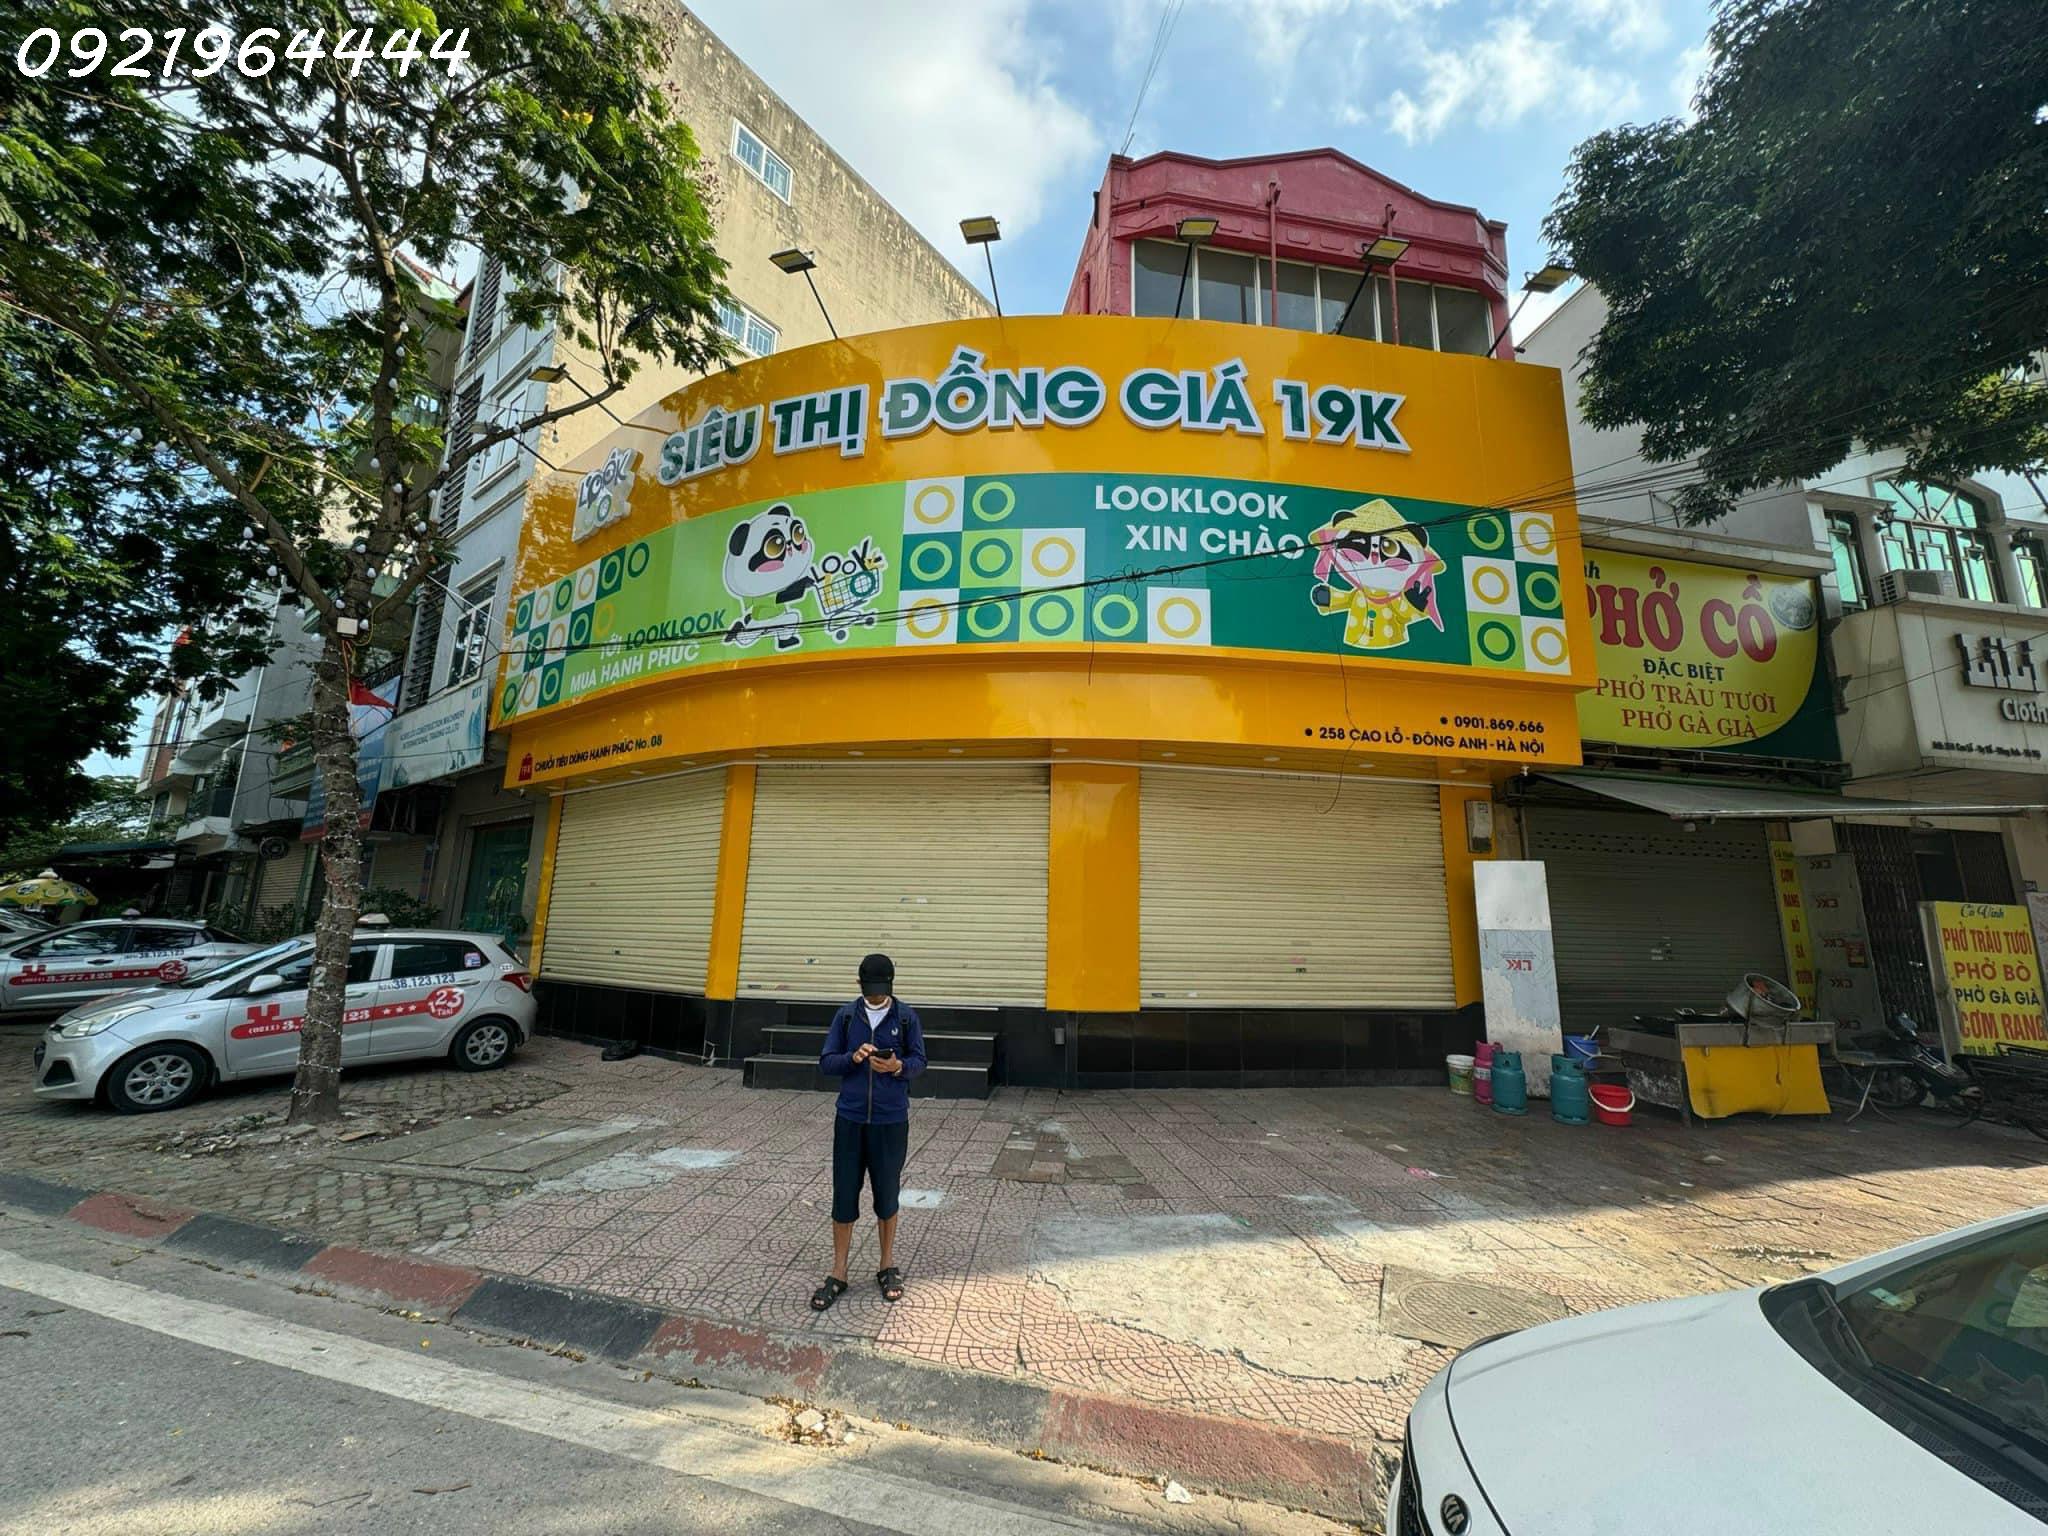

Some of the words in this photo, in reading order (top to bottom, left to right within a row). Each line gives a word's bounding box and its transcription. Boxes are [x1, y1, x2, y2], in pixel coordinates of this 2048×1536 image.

[658, 406, 762, 482] SIÊU
[771, 386, 867, 455] THỊ
[882, 347, 1104, 435] ĐỒNG
[1121, 360, 1261, 433] GIÁ
[1274, 380, 1409, 450] 19K
[1095, 485, 1289, 520] LOOKLOOK
[1125, 523, 1188, 552] XIN
[1199, 524, 1305, 560] CHÀO
[626, 608, 726, 650] LOOKLOOK
[570, 669, 597, 693] MUA
[600, 653, 643, 684] HẠNH
[1643, 657, 1684, 680] ĐẶC
[1687, 663, 1725, 684] BIỆT
[1595, 674, 1645, 700] PHỞ
[1652, 682, 1714, 706] TRÂU
[1721, 692, 1777, 713] TƯƠI
[1454, 716, 1544, 734] 0901.869.666
[1621, 704, 1673, 730] PHỞ
[1679, 710, 1712, 735] GÀ
[1717, 713, 1759, 738] GIÀ
[1319, 727, 1345, 740] 258
[1349, 729, 1381, 743] CAO
[1412, 731, 1455, 747] ĐÔNG
[1458, 735, 1488, 750] ANH
[1496, 737, 1516, 753] HÀ
[1520, 740, 1545, 757] NỘI
[1942, 921, 1968, 951] PHỞ
[1970, 926, 2001, 953] TRÂU
[2004, 924, 2032, 955] TƯƠI
[314, 966, 327, 987] 2
[1954, 957, 1997, 981] PHỞ
[2002, 961, 2031, 982] BÒ
[1954, 984, 1986, 1003] PHỞ
[1989, 987, 2011, 1005] GÀ
[2014, 988, 2041, 1006] GIÀ
[1959, 1009, 1999, 1039] CƠM
[2002, 1013, 2047, 1041] RANG
